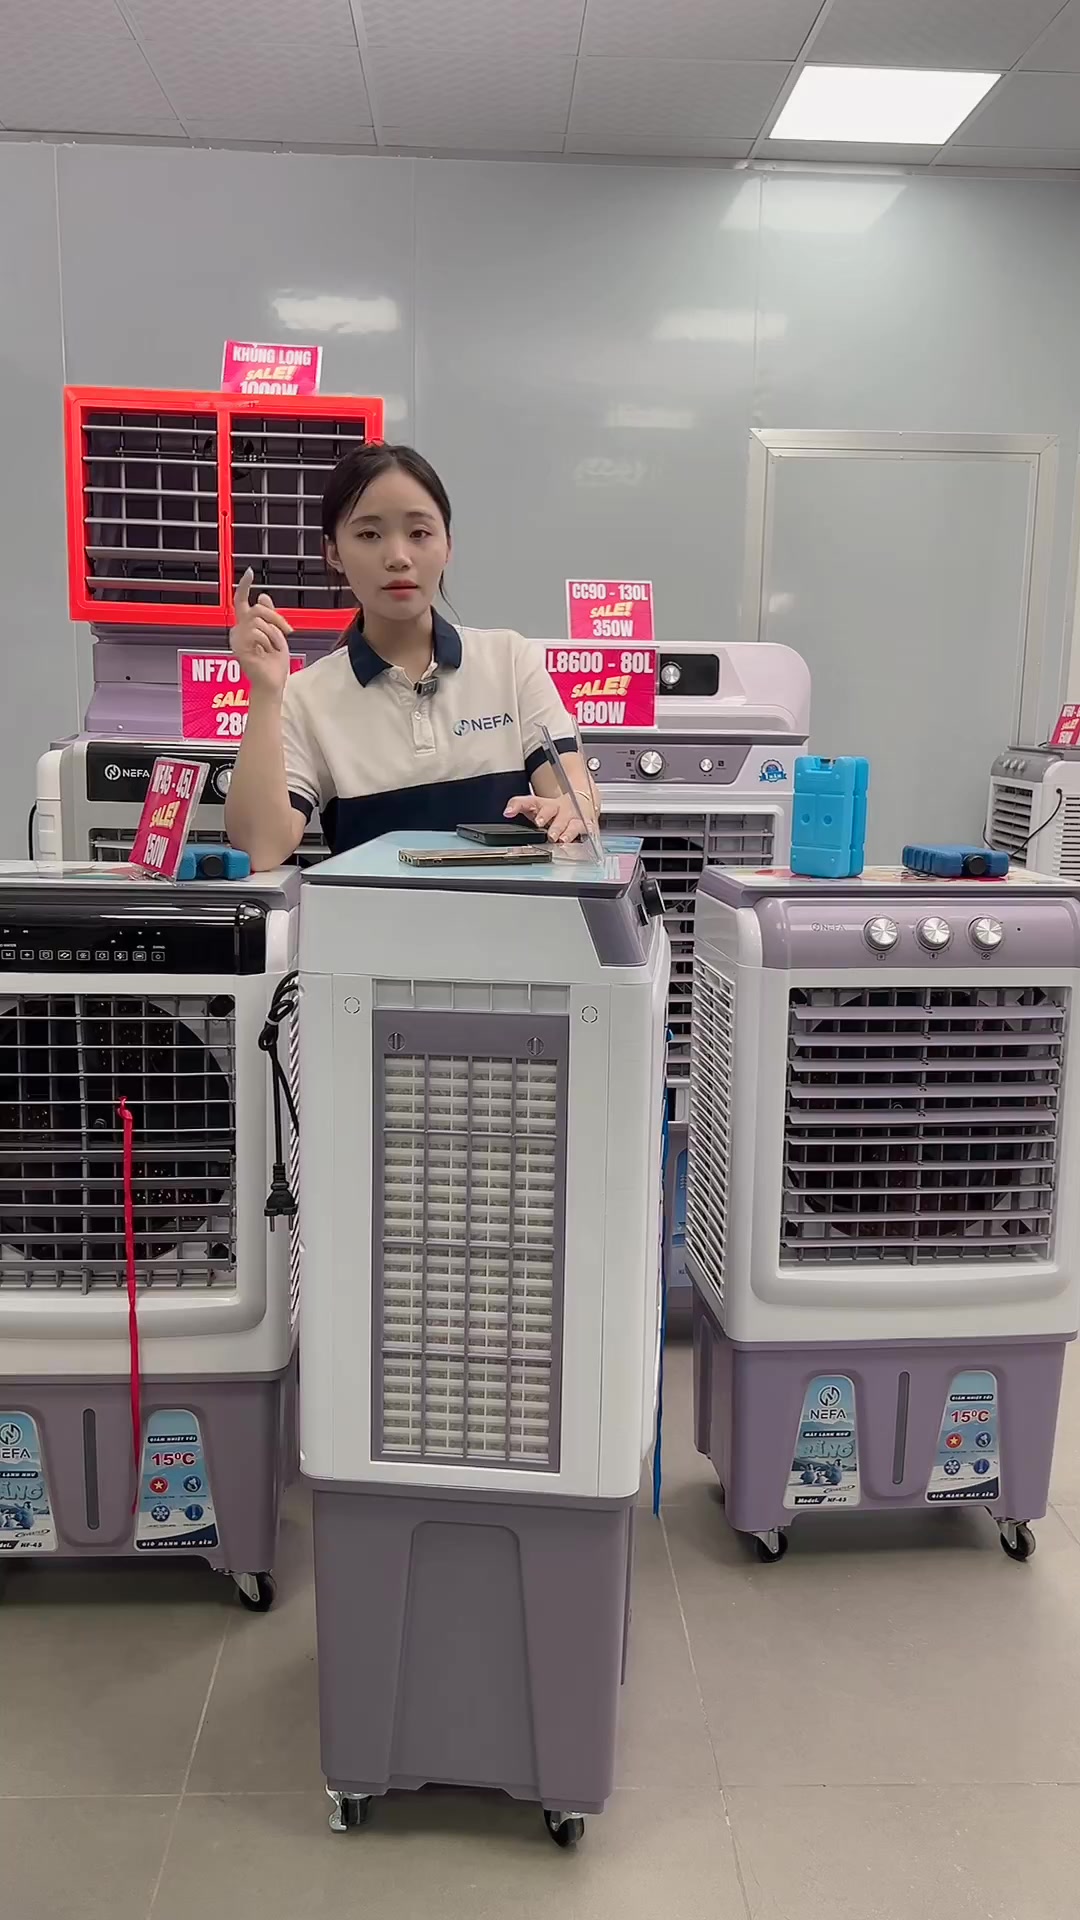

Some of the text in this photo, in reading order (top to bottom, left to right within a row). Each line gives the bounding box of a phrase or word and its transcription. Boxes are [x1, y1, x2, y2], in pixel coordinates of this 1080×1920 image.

[279, 349, 312, 366] LONG
[245, 365, 297, 381] SALE!
[572, 583, 606, 600] CC90
[618, 584, 649, 601] 130L
[589, 601, 634, 618] SALE!
[592, 619, 634, 637] 350W
[191, 658, 241, 683] NF70
[547, 651, 603, 674] L8600
[620, 651, 654, 674] 80L
[571, 675, 632, 698] SALE!
[211, 689, 249, 709] SAL
[574, 701, 626, 724] 180W
[471, 713, 513, 731] NEFA
[122, 768, 151, 778] NEFA
[810, 1409, 846, 1420] NEFA
[0, 1448, 31, 1459] EFA
[0, 1481, 44, 1501] ĂNG
